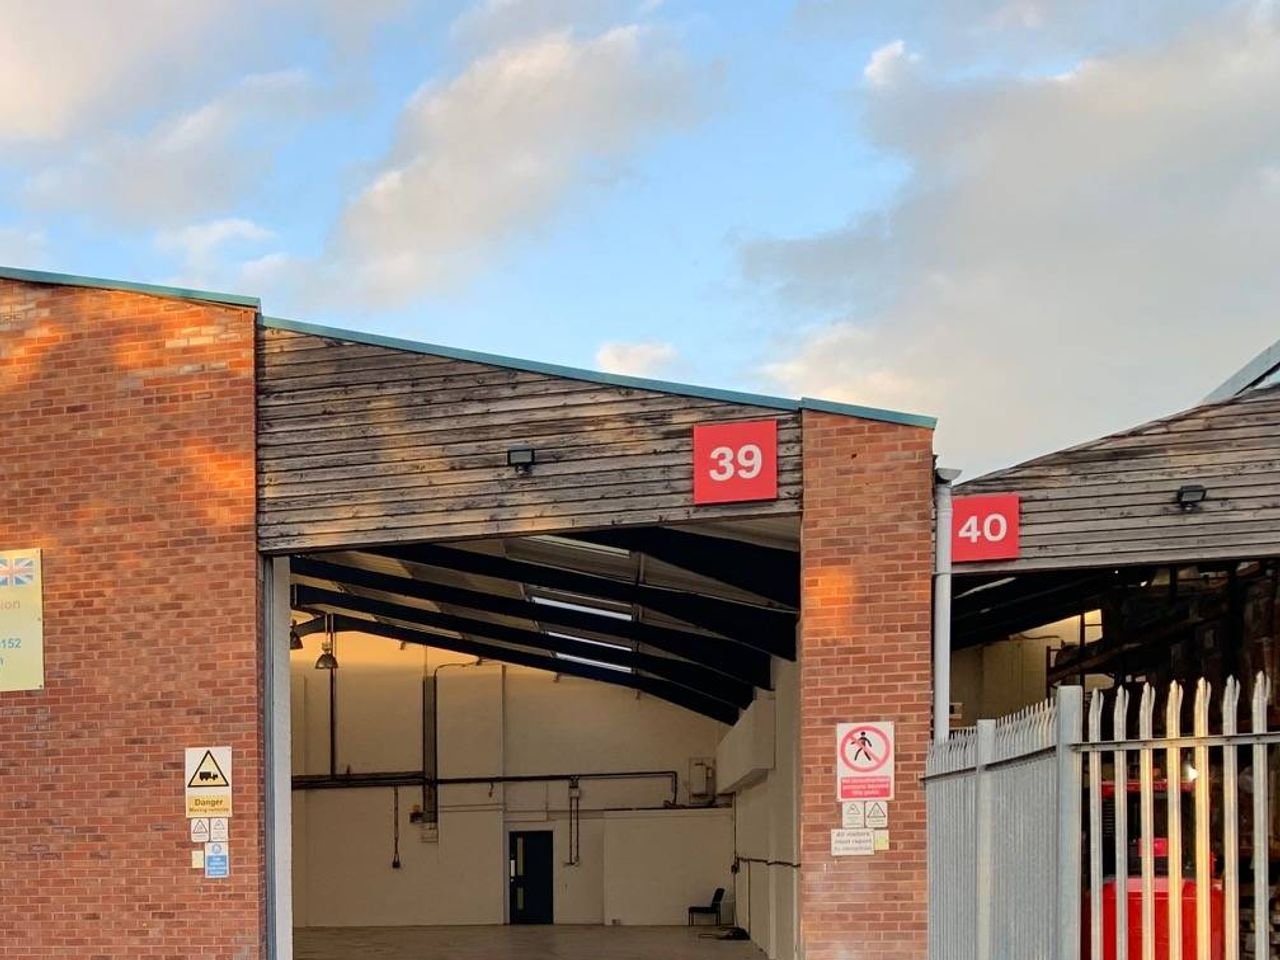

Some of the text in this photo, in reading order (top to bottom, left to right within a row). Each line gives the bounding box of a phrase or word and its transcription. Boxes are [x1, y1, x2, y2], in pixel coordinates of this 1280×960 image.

[709, 444, 762, 481] 39
[958, 513, 1008, 544] 40
[194, 798, 224, 807] Danger
